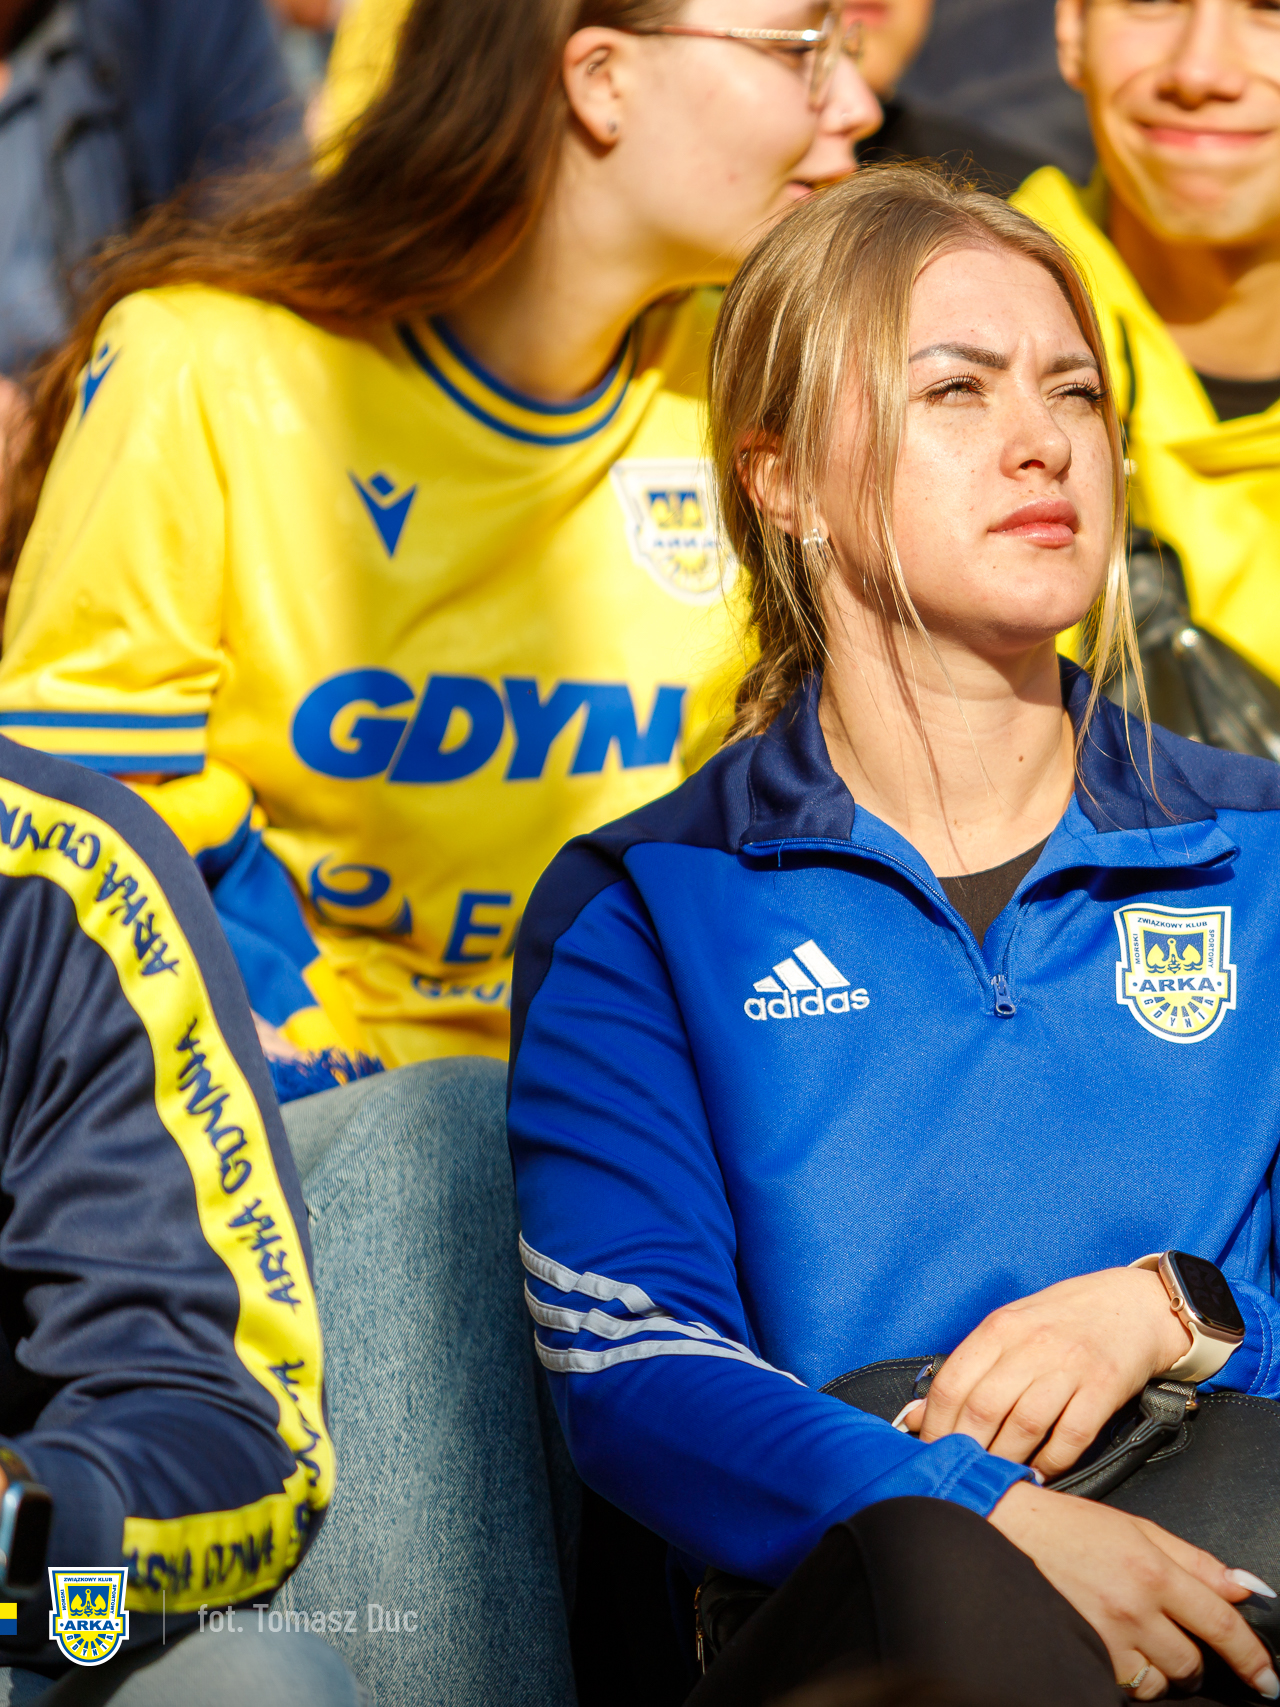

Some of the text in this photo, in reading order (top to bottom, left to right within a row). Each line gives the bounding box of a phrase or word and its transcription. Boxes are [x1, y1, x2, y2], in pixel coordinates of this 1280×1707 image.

[1137, 916, 1208, 929] ZWIĄZKOWY KLUB
[1132, 933, 1141, 965] MORSKI
[1139, 977, 1216, 992] ARKA
[743, 986, 870, 1021] adidas
[1143, 998, 1214, 1029] GDYNIA
